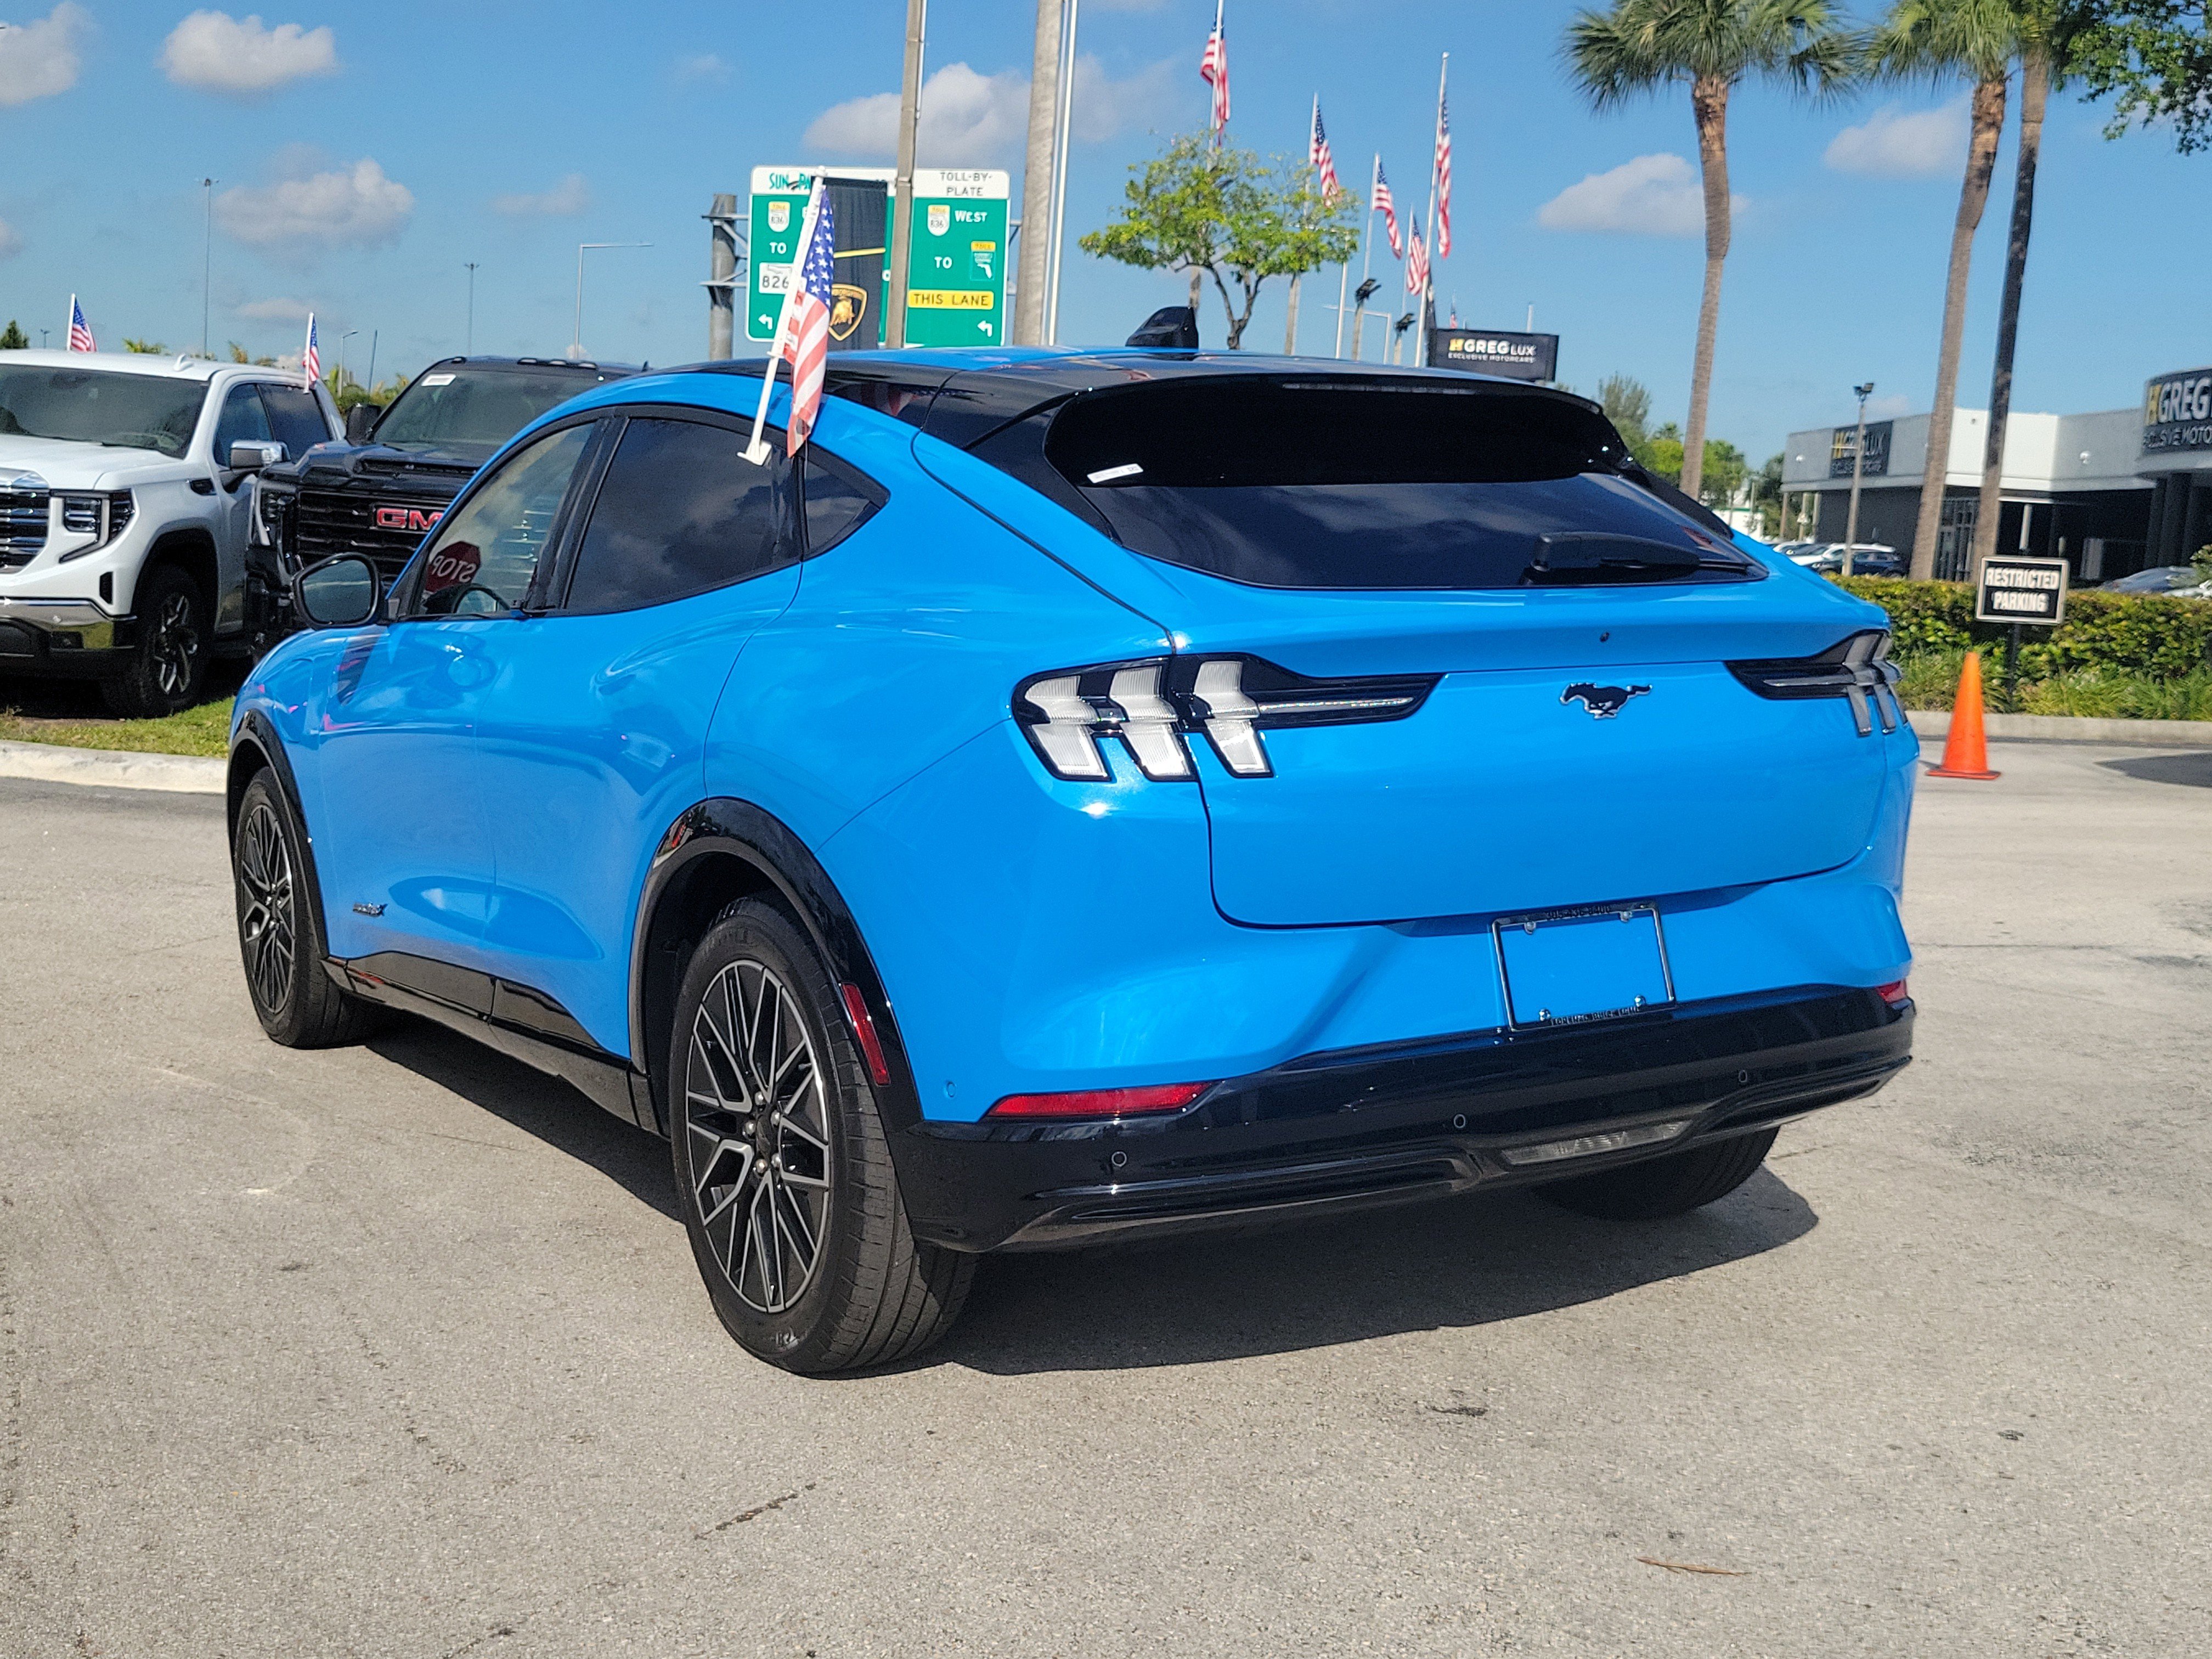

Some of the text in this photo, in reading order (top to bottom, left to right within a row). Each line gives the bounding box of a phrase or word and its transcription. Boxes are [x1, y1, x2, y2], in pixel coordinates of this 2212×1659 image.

[940, 172, 993, 182] TOLL-BY-
[946, 187, 983, 196] PLATE
[955, 210, 987, 223] WEST
[769, 242, 786, 254] TO
[934, 256, 952, 269] TO
[762, 275, 789, 289] 826
[914, 294, 989, 306] THIS LANE
[1510, 344, 1536, 356] LUX
[376, 508, 444, 531] GM
[1985, 567, 2060, 590] RESTRICTED
[1992, 590, 2050, 612] PARKING
